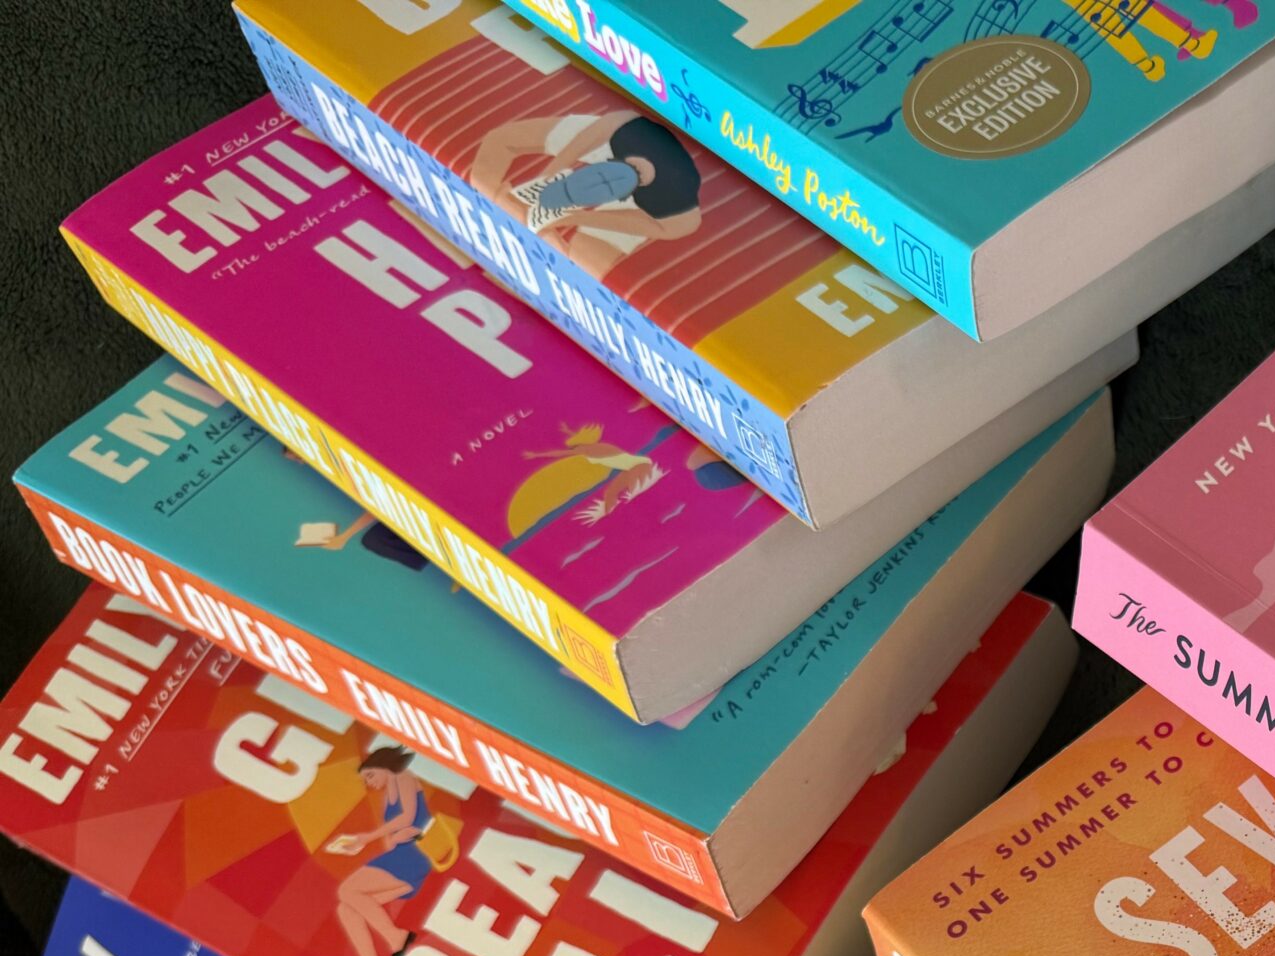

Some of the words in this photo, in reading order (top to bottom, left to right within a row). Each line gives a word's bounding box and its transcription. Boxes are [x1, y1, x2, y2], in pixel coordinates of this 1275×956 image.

[576, 0, 666, 99] Love
[925, 82, 977, 119] BARNES
[974, 75, 986, 87] &
[985, 49, 1028, 81] NOBLE
[936, 56, 1052, 134] EXCLUSIVE
[971, 80, 1062, 142] EDITION
[163, 164, 196, 186] #1
[205, 132, 250, 164] NEW
[720, 111, 796, 194] Ashley
[804, 168, 885, 246] Poston
[129, 127, 351, 274] EMIL
[264, 184, 371, 252] beach-read
[311, 82, 440, 216] BEACH
[431, 176, 541, 296] READ
[545, 268, 631, 362] EMILY
[632, 335, 728, 440] HENRY
[129, 286, 235, 398] HAPPY
[224, 359, 334, 475] PLACE
[339, 447, 445, 563] EMILY
[443, 526, 560, 653] HENRY
[176, 443, 199, 465] #1
[450, 453, 463, 467] A
[469, 404, 533, 453] NOVEL
[1194, 436, 1254, 494] NEW
[153, 468, 212, 515] PEOPLE
[211, 443, 240, 468] WE
[868, 528, 924, 594] JENKINS
[1108, 592, 1167, 637] The
[0, 593, 188, 804] EMILY
[48, 512, 173, 613] BOOK
[159, 569, 328, 694] LOVERS
[338, 668, 470, 768] EMILY
[476, 740, 618, 846] HENRY
[746, 622, 814, 699] rom-com
[93, 764, 119, 791] #1
[118, 713, 150, 759] NEW
[149, 664, 186, 712] YORK
[932, 865, 986, 909] SIX
[994, 755, 1128, 861] SUMMERS
[1136, 720, 1174, 753] TO
[946, 886, 1009, 939] ONE
[1019, 791, 1139, 884] SUMMER
[1145, 753, 1184, 788] TO
